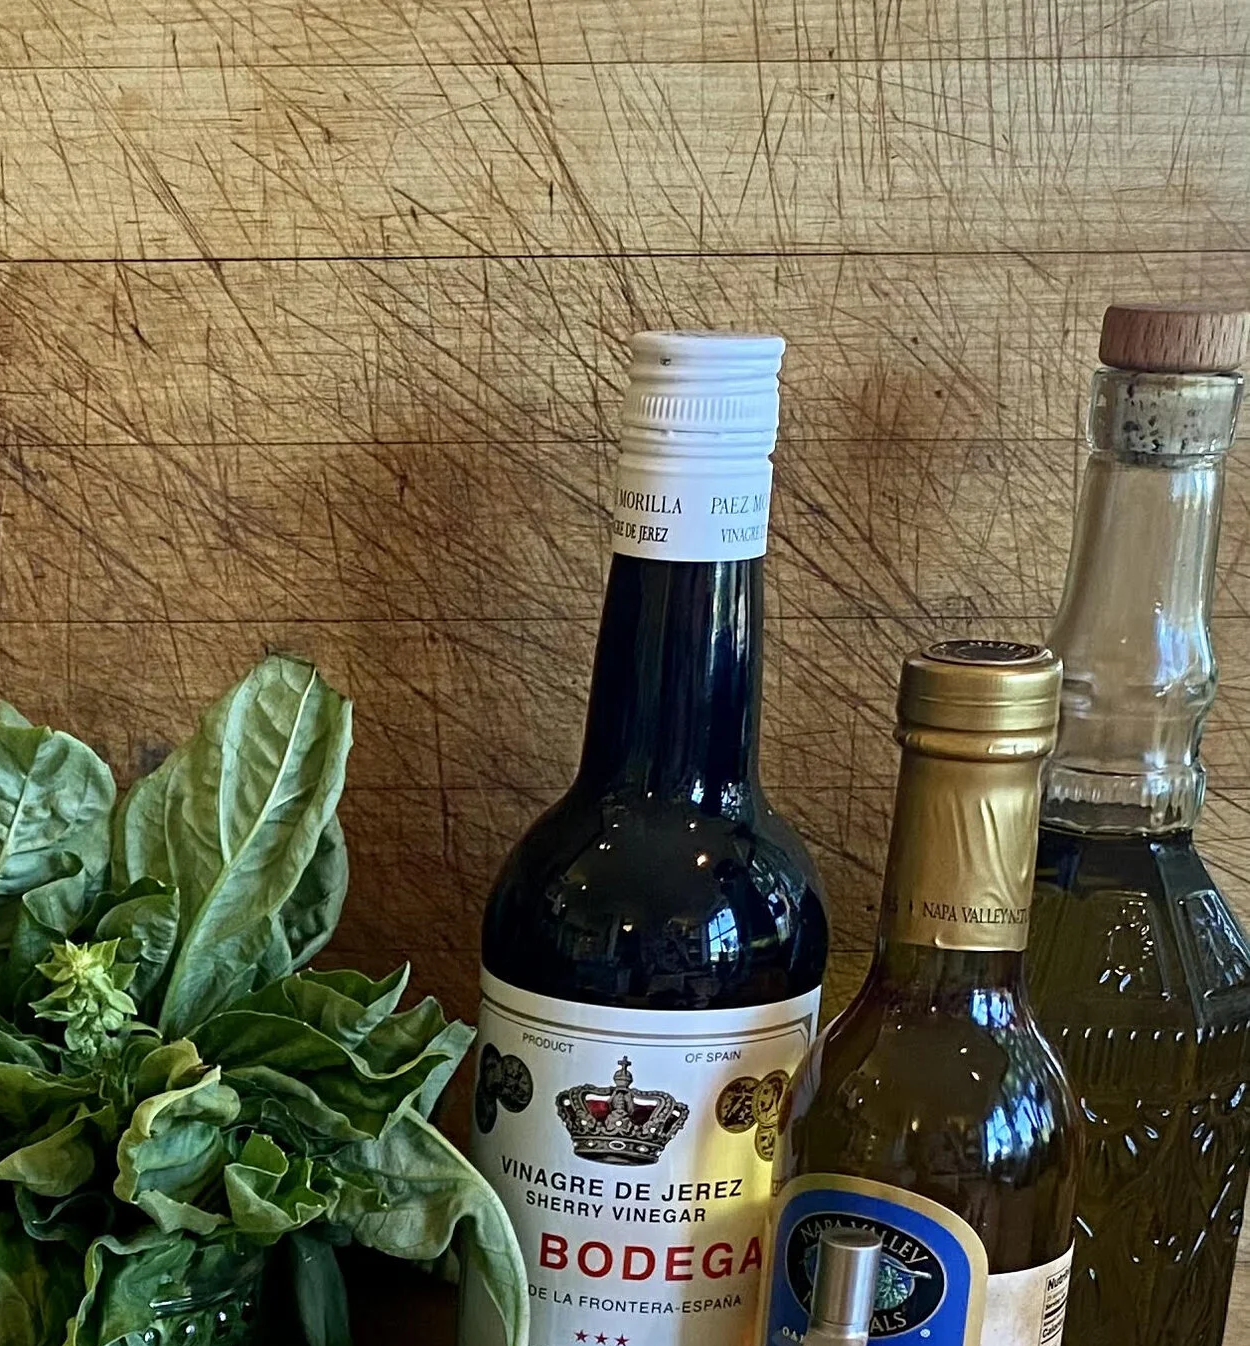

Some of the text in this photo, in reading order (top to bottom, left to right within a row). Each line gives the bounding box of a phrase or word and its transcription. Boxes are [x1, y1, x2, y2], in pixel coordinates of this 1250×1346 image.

[710, 495, 749, 514] PAEZ
[625, 522, 637, 539] DE
[637, 525, 669, 544] JEREZ
[923, 902, 957, 921] NAPA
[962, 907, 1008, 924] VALLEY
[521, 1031, 575, 1055] PRODUCT
[684, 1049, 742, 1063] OF SPAIN
[501, 1155, 743, 1202] VINAGRE DE JEREZ
[525, 1190, 706, 1223] SHERRY VINEGAR
[539, 1232, 763, 1281] BODEGA
[528, 1284, 547, 1300] DE
[553, 1290, 573, 1305] LA
